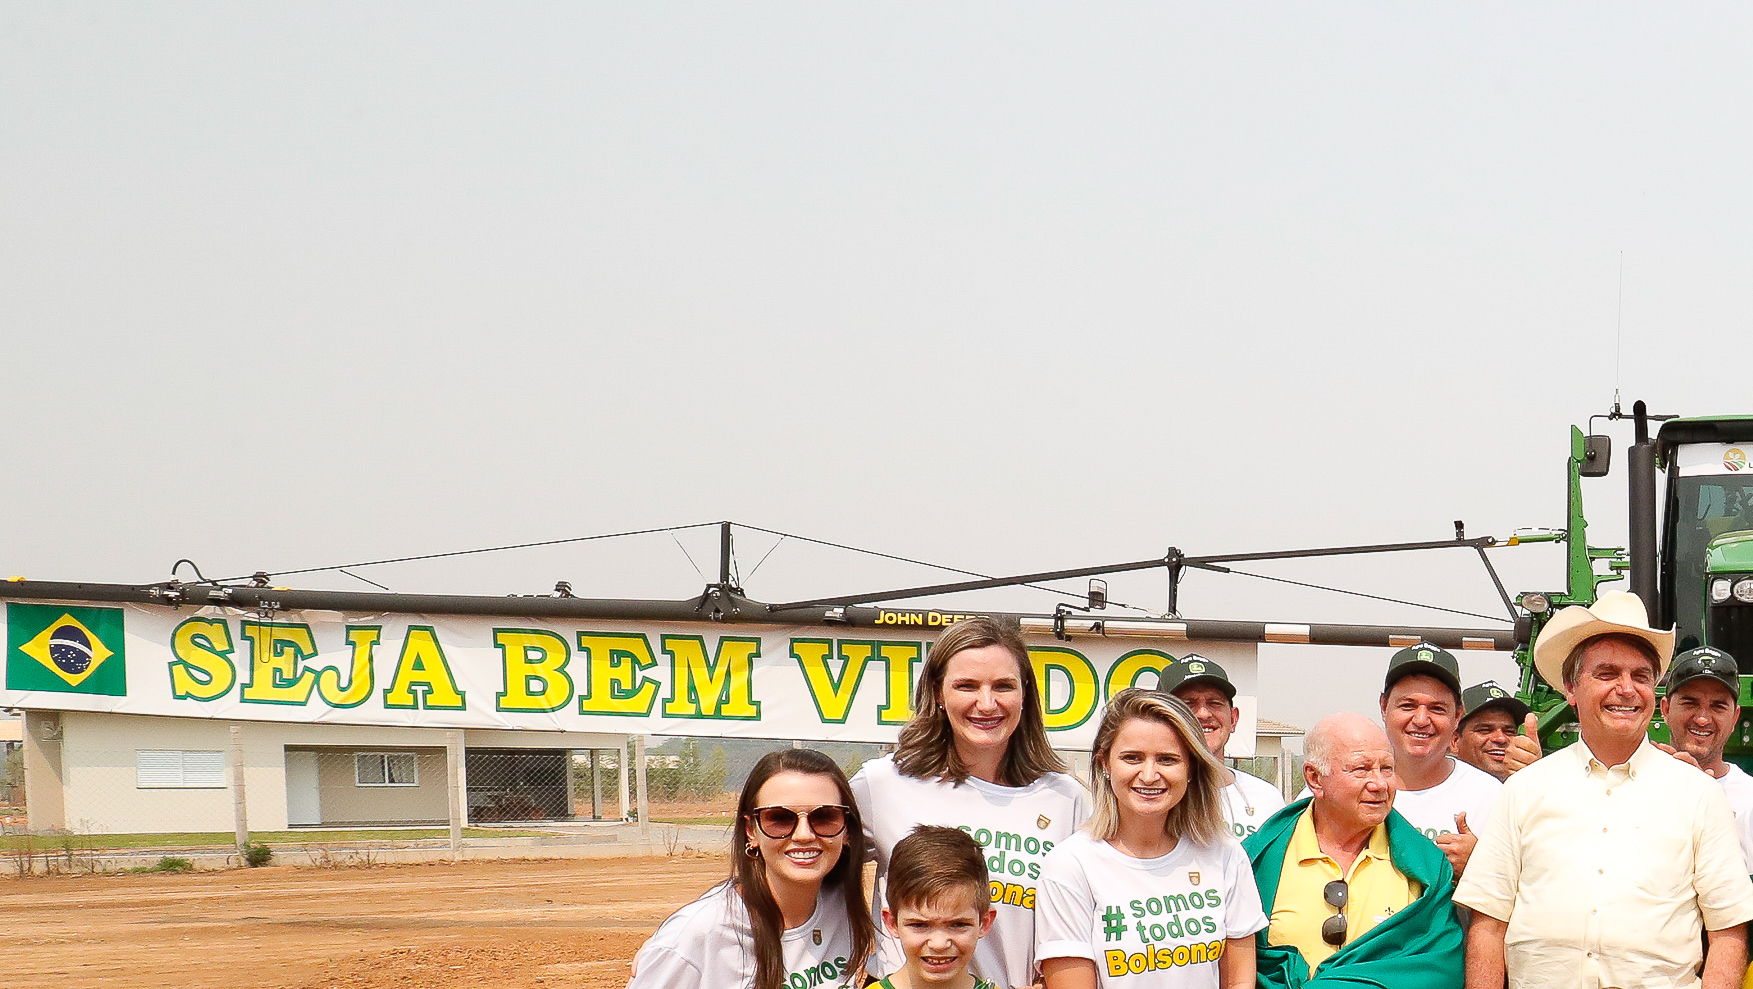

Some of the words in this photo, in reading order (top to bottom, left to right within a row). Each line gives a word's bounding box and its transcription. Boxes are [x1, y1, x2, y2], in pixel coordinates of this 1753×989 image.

[874, 610, 923, 625] JOHN
[927, 611, 990, 626] DEE
[168, 616, 467, 711] SEJA
[492, 627, 762, 721] BEM
[789, 638, 1180, 732] VID
[987, 850, 1041, 880] dos
[1129, 888, 1222, 918] somos
[1135, 913, 1218, 943] todos
[1104, 938, 1227, 977] Bolsona
